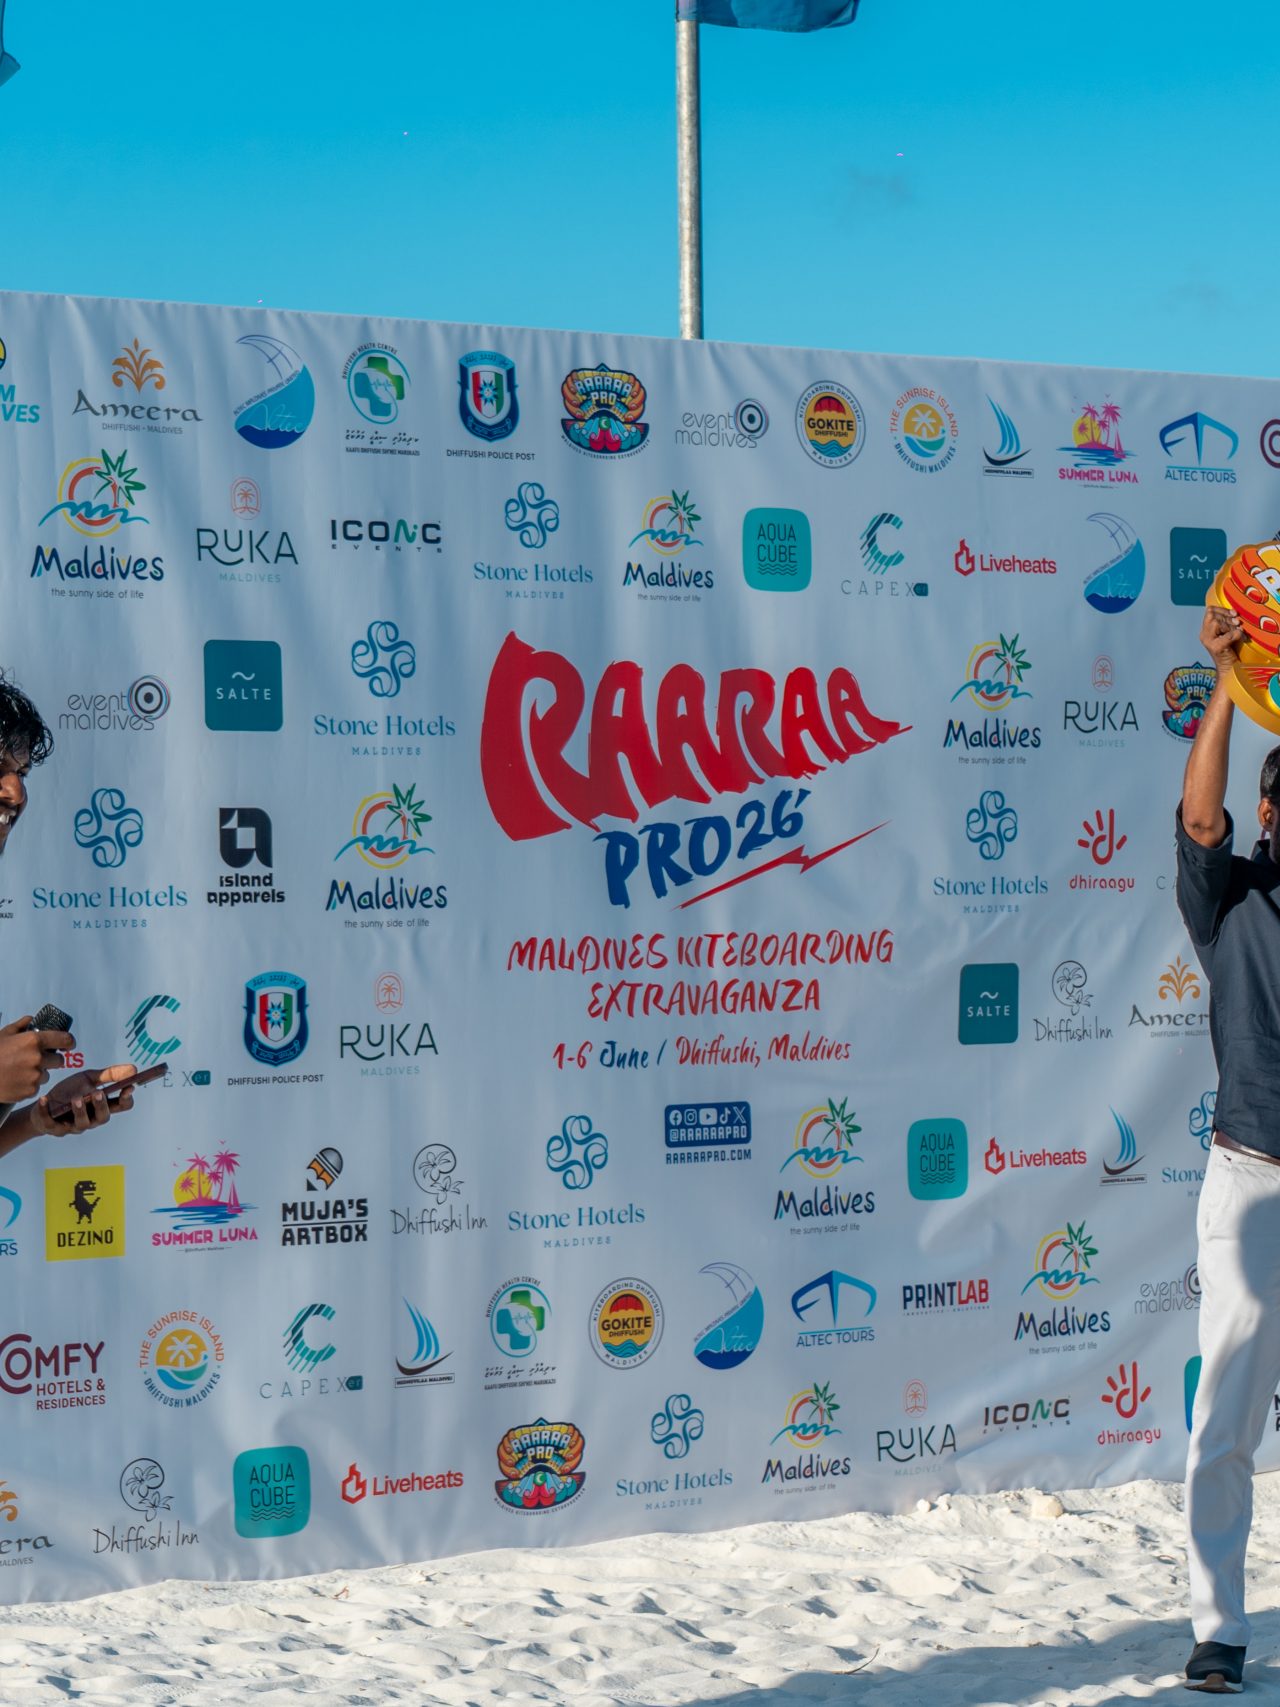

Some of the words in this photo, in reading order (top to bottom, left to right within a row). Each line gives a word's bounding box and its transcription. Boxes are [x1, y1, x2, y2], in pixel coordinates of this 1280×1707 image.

[72, 388, 202, 421] Ameera
[591, 391, 617, 405] PRO
[799, 385, 834, 418] KITEBOARDING
[836, 387, 862, 423] DHIFFUSHI
[681, 410, 736, 429] event
[889, 411, 899, 433] THE
[896, 387, 935, 409] SUNRISE
[936, 392, 959, 438] ISLAND
[102, 422, 143, 434] DHIFFUSHI
[145, 424, 182, 436] MALDIVES
[807, 417, 855, 433] GOKITE
[814, 429, 849, 439] DHIFFUSHI
[675, 428, 758, 449] maldives
[447, 449, 486, 458] DHIFFUSHI
[488, 451, 513, 460] POLICE
[811, 450, 854, 465] MALDIVES
[894, 443, 928, 473] DHIFFUSHI
[928, 444, 957, 473] MALDIVES
[1059, 468, 1104, 482] SUMMER
[1109, 469, 1139, 484] LUNA
[1165, 469, 1198, 482] ALTEC
[1201, 470, 1236, 484] TOURS
[757, 523, 797, 543] AQUA
[196, 528, 298, 566] RUKA
[757, 544, 798, 564] CUBE
[31, 545, 163, 581] Maldives
[474, 563, 528, 580] Stone
[535, 564, 593, 583] Hotels
[980, 554, 1056, 574] Liveheats
[217, 572, 283, 585] MALDIVES
[623, 562, 713, 588] Maldives
[51, 588, 68, 598] the
[71, 588, 95, 600] sunny
[97, 588, 115, 599] side
[118, 589, 128, 599] of
[130, 589, 144, 599] life
[505, 590, 564, 600] MALDIVES
[840, 579, 914, 598] CAPEX
[68, 692, 129, 713] event
[216, 687, 272, 701] SALTE
[59, 711, 155, 732] maldives
[314, 715, 377, 735] Stone
[387, 715, 455, 735] Hotels
[1064, 701, 1139, 733] RUKA
[480, 630, 914, 841] RAARAA
[943, 719, 1041, 748] Maldives
[1079, 739, 1124, 747] MALDIVES
[352, 747, 421, 755] MALDIVES
[219, 872, 273, 888] island
[934, 878, 985, 895] Stone
[992, 876, 1048, 894] Hotels
[1070, 875, 1134, 892] dhiraagu
[33, 888, 101, 908] Stone
[106, 886, 187, 907] Hotels
[207, 888, 285, 907] apparels
[326, 877, 447, 911] Maldives
[73, 918, 150, 930] MALDIVES
[344, 918, 358, 929] the
[360, 919, 383, 931] sunny
[385, 918, 404, 928] side
[406, 918, 416, 928] of
[417, 917, 430, 928] life
[508, 934, 668, 972] MALDIVES
[678, 930, 893, 967] KITEBOARDING
[588, 979, 819, 1019] EXTRAVAGANZA
[967, 1005, 1010, 1018] SALTE
[1128, 1004, 1210, 1029] Ameer
[1033, 1016, 1092, 1042] Dhiffushi
[1095, 1016, 1112, 1039] Inn
[340, 1023, 438, 1061] RUKA
[553, 1041, 592, 1069] 1-6
[600, 1041, 648, 1069] June
[676, 1034, 760, 1067] Dhiffushi,
[768, 1031, 851, 1061] Maldives
[228, 1077, 273, 1085] DHIFFUSHI
[272, 1075, 300, 1083] POLICE
[303, 1074, 324, 1082] POST
[361, 1065, 422, 1076] MALDIVES
[669, 1124, 748, 1143] @RAARAAPRO
[920, 1133, 954, 1152] AQUA
[666, 1149, 751, 1164] RAARAAPRO.COM
[920, 1153, 955, 1173] CUBE
[1010, 1149, 1087, 1168] Liveheats
[282, 1198, 368, 1222] MUJA'S
[774, 1186, 874, 1220] Maldives
[389, 1204, 462, 1236] Dhiffushi
[465, 1203, 488, 1231] Inn
[508, 1211, 570, 1231] Stone
[578, 1203, 645, 1226] Hotels
[57, 1228, 114, 1248] DEZINO
[152, 1227, 213, 1246] SUMMER
[219, 1227, 258, 1242] LUNA
[282, 1224, 368, 1247] ARTBOX
[544, 1236, 611, 1247] MALDIVES
[1140, 1280, 1186, 1299] event
[593, 1282, 634, 1321] KITEBOARDING
[635, 1283, 661, 1318] DHIFFUSHI
[601, 1315, 652, 1333] GOKITE
[608, 1328, 645, 1339] DHIFFUSHI
[1014, 1307, 1110, 1340] Maldives
[139, 1345, 151, 1369] THE
[147, 1310, 197, 1340] SUNRISE
[198, 1315, 225, 1362] ISLAND
[796, 1332, 832, 1348] ALTEC
[835, 1329, 875, 1346] TOURS
[0, 1333, 105, 1395] COMFY
[604, 1350, 649, 1366] MALDIVES
[36, 1379, 92, 1397] HOTELS
[97, 1378, 105, 1391] &
[143, 1377, 184, 1409] DHIFFUSHI
[185, 1372, 221, 1407] MALDIVES
[259, 1376, 347, 1399] CAPEX
[36, 1394, 106, 1411] RESIDENCES
[510, 1430, 570, 1450] RAARAA
[877, 1424, 956, 1462] RUKA
[1097, 1430, 1161, 1445] dhiraagu
[526, 1445, 554, 1461] PRO
[249, 1462, 295, 1484] AQUA
[762, 1454, 850, 1482] Maldives
[373, 1470, 463, 1495] Liveheats
[616, 1479, 669, 1496] Stone
[675, 1469, 732, 1490] Hotels
[250, 1484, 296, 1508] CUBE
[92, 1521, 172, 1555] Dhiffushi
[175, 1519, 199, 1546] Inn
